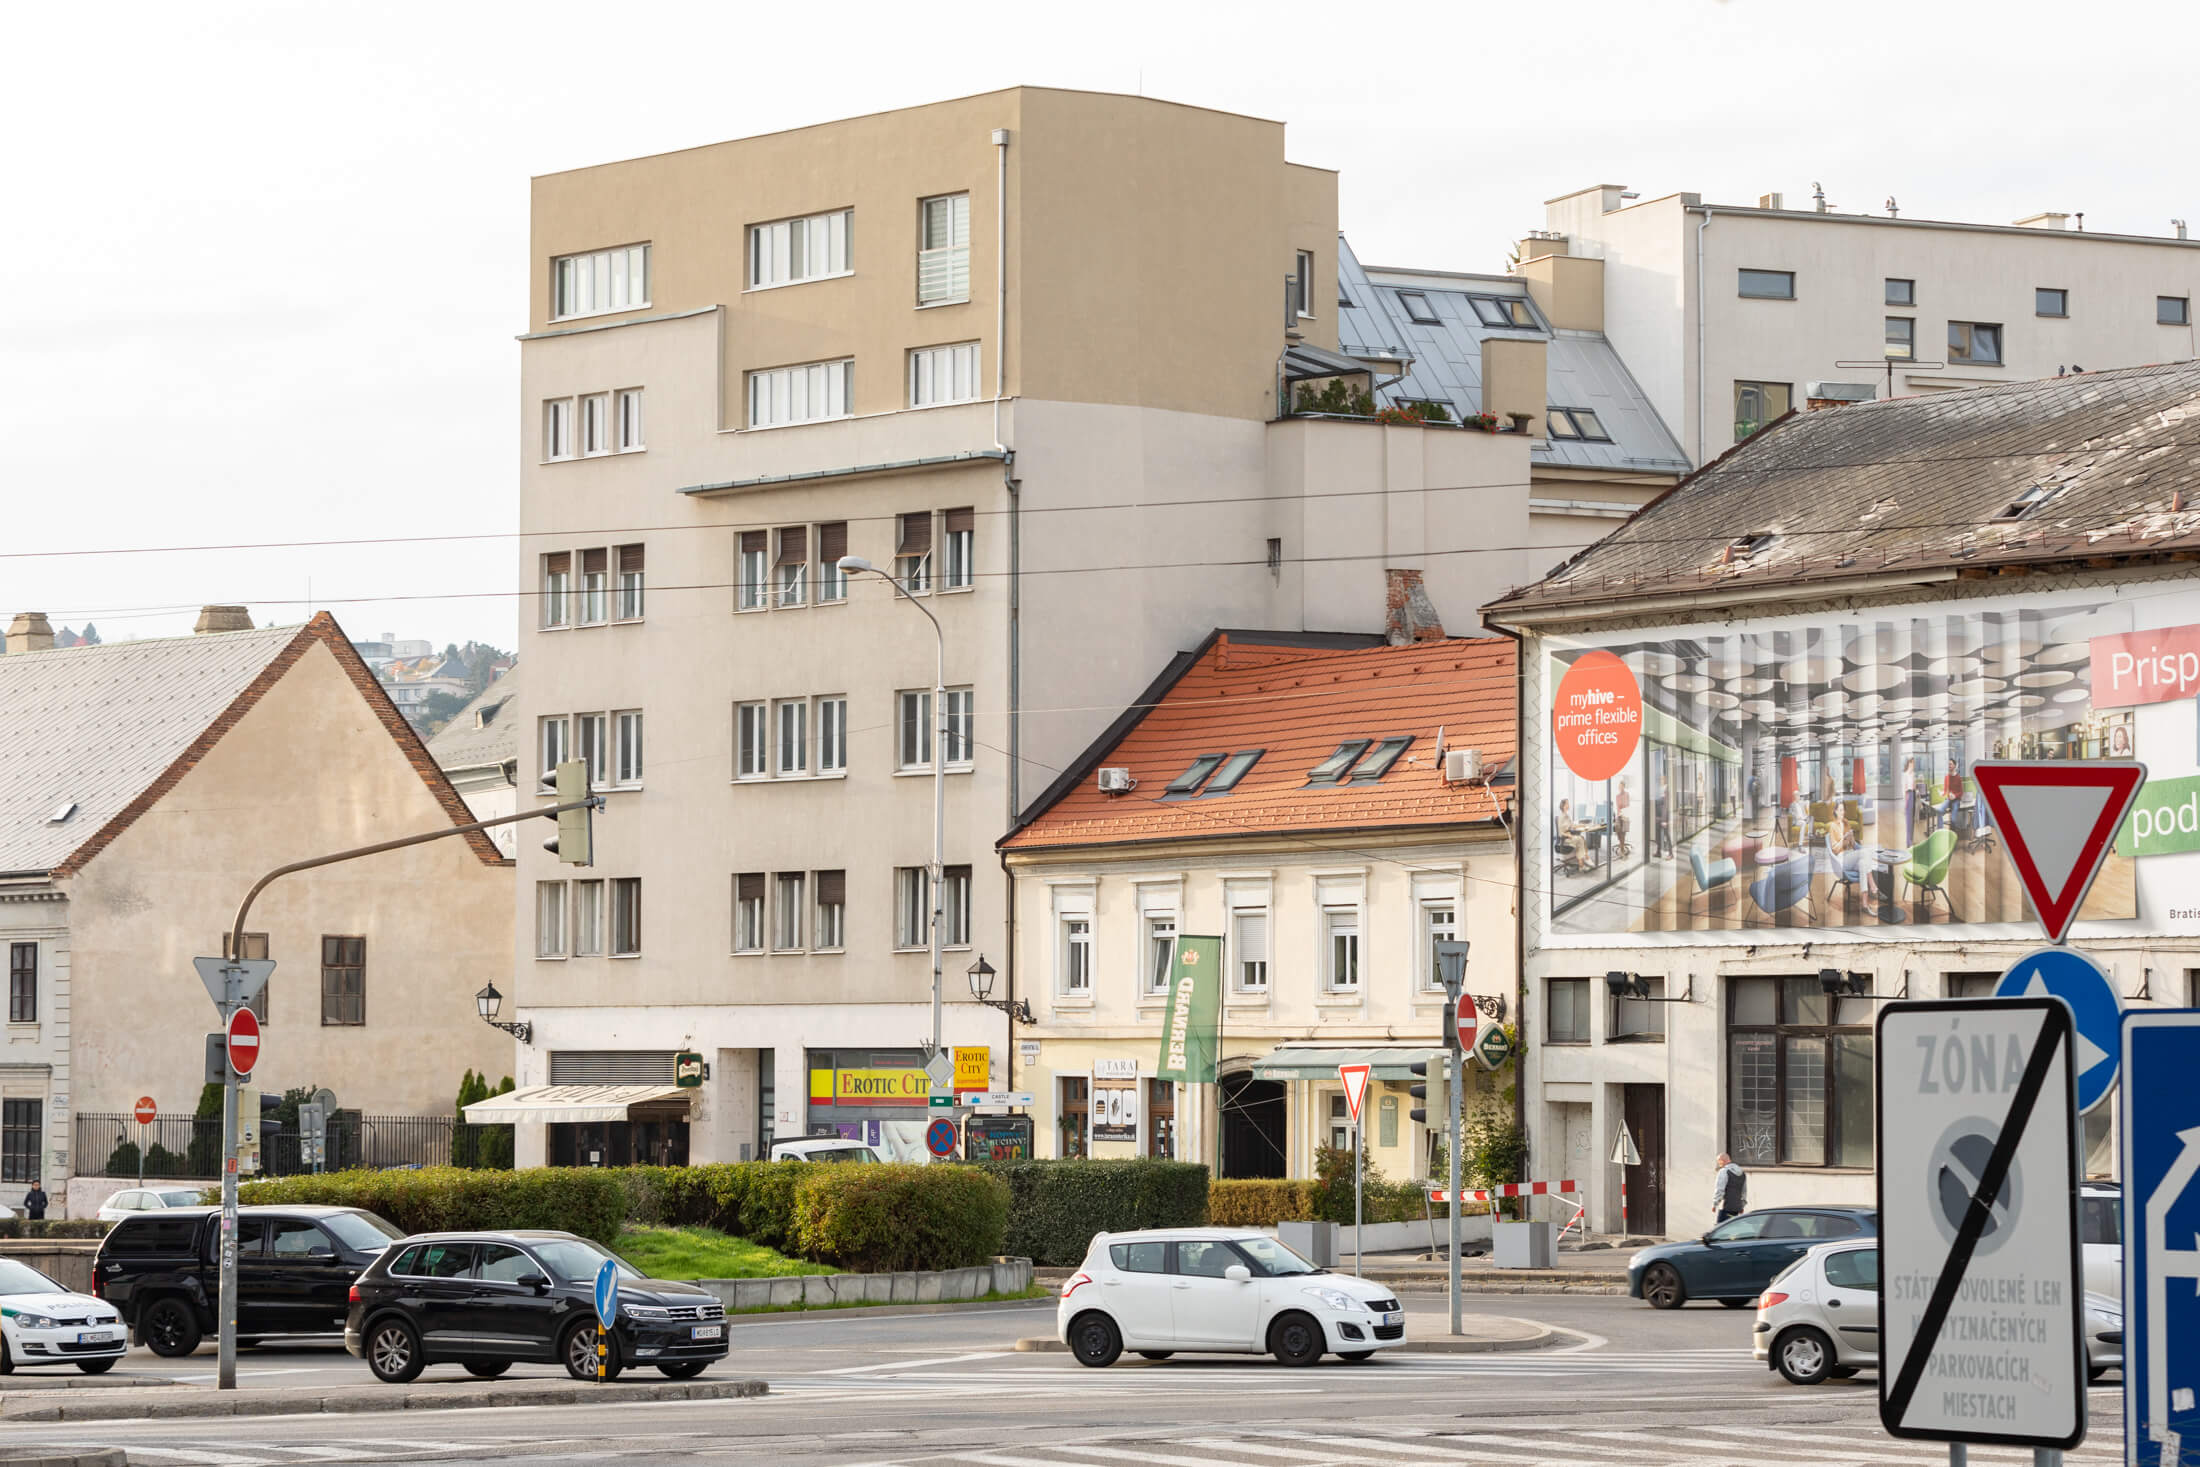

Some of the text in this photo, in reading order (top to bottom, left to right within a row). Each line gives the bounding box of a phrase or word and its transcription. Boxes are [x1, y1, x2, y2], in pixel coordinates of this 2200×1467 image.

[2111, 645, 2199, 693] Prisp
[1570, 688, 1615, 710] myhive
[1558, 706, 1637, 731] prime flexible
[1577, 728, 1618, 746] offices
[2132, 791, 2198, 849] pod
[1167, 976, 1194, 1073] BERNARD
[1915, 1017, 2028, 1094] ZÓNA
[902, 1073, 932, 1095] CIT
[1959, 1273, 2026, 1305] OVOLENÉ
[2034, 1280, 2062, 1306] LEN
[1928, 1349, 2030, 1383] PARKOVACÍCH
[1943, 1391, 2016, 1421] MIESTACH
